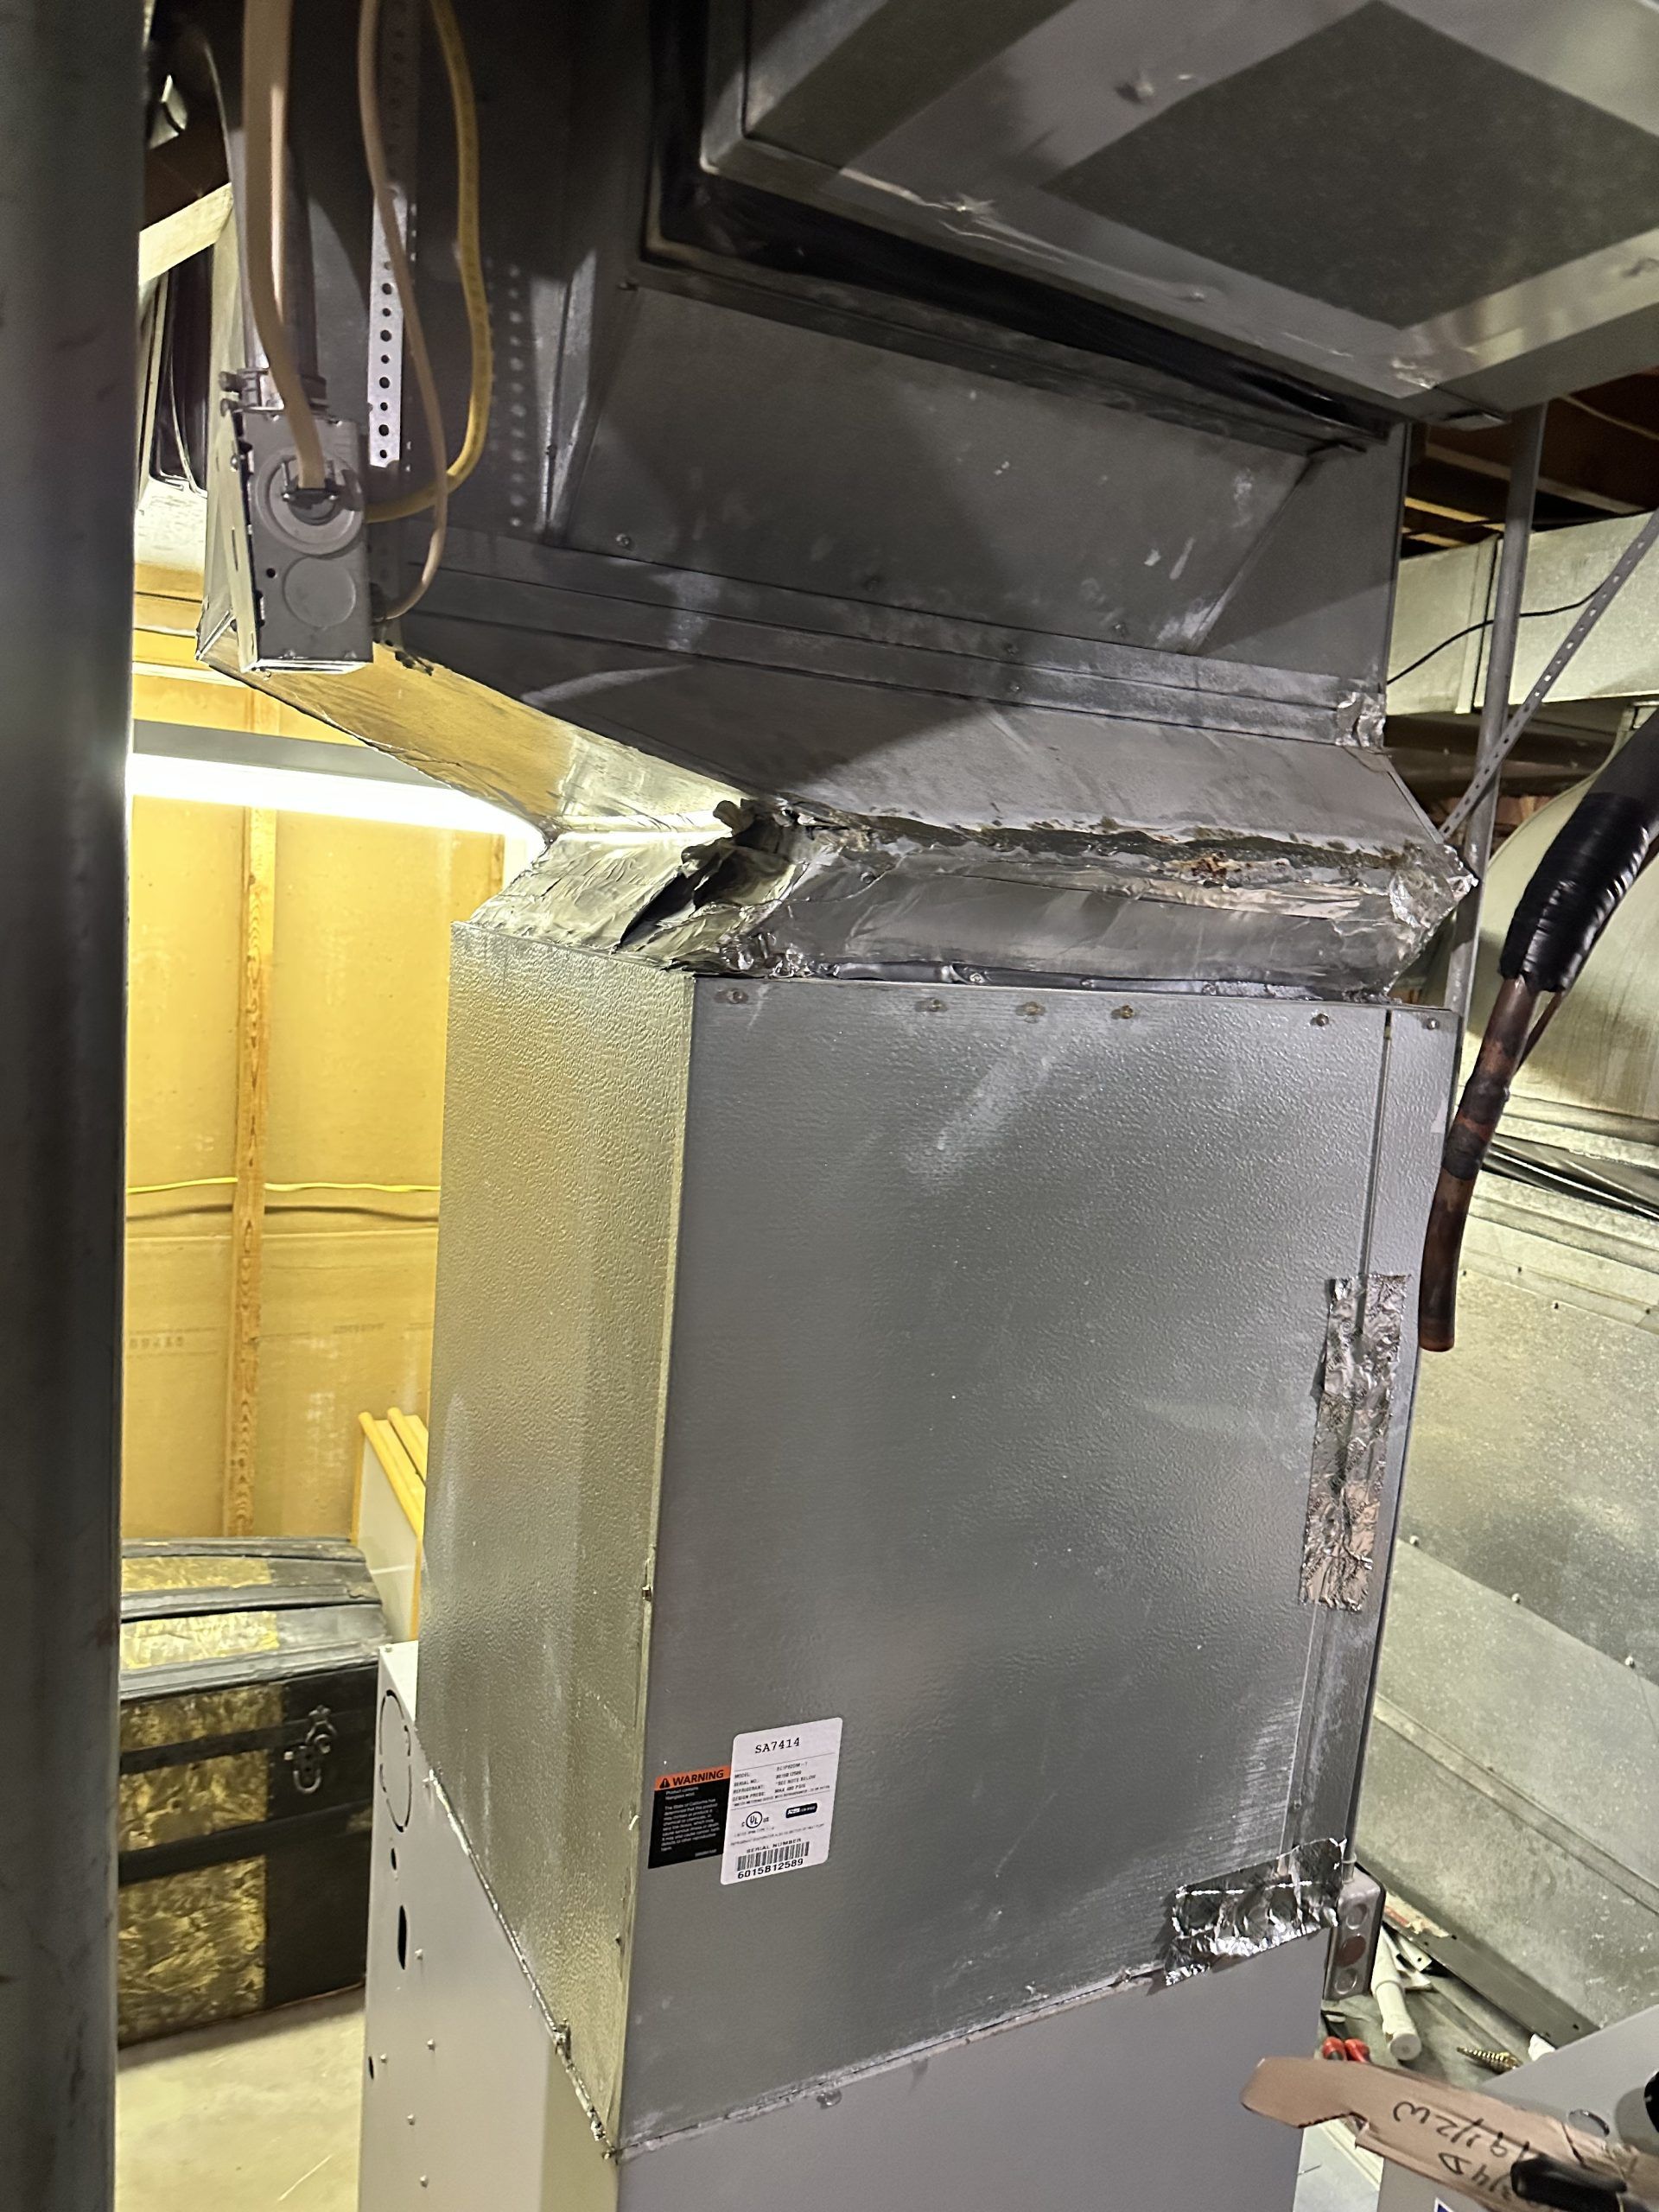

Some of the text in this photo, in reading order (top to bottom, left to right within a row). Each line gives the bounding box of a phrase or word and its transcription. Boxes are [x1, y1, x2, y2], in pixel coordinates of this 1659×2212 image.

[755, 1737, 800, 1754] SA7414
[672, 1769, 724, 1786] WARNING
[747, 1845, 770, 1853] SERIAL
[772, 1838, 801, 1847] NUMBER
[738, 1858, 804, 1879] 6015B12589
[1393, 2101, 1431, 2125] W
